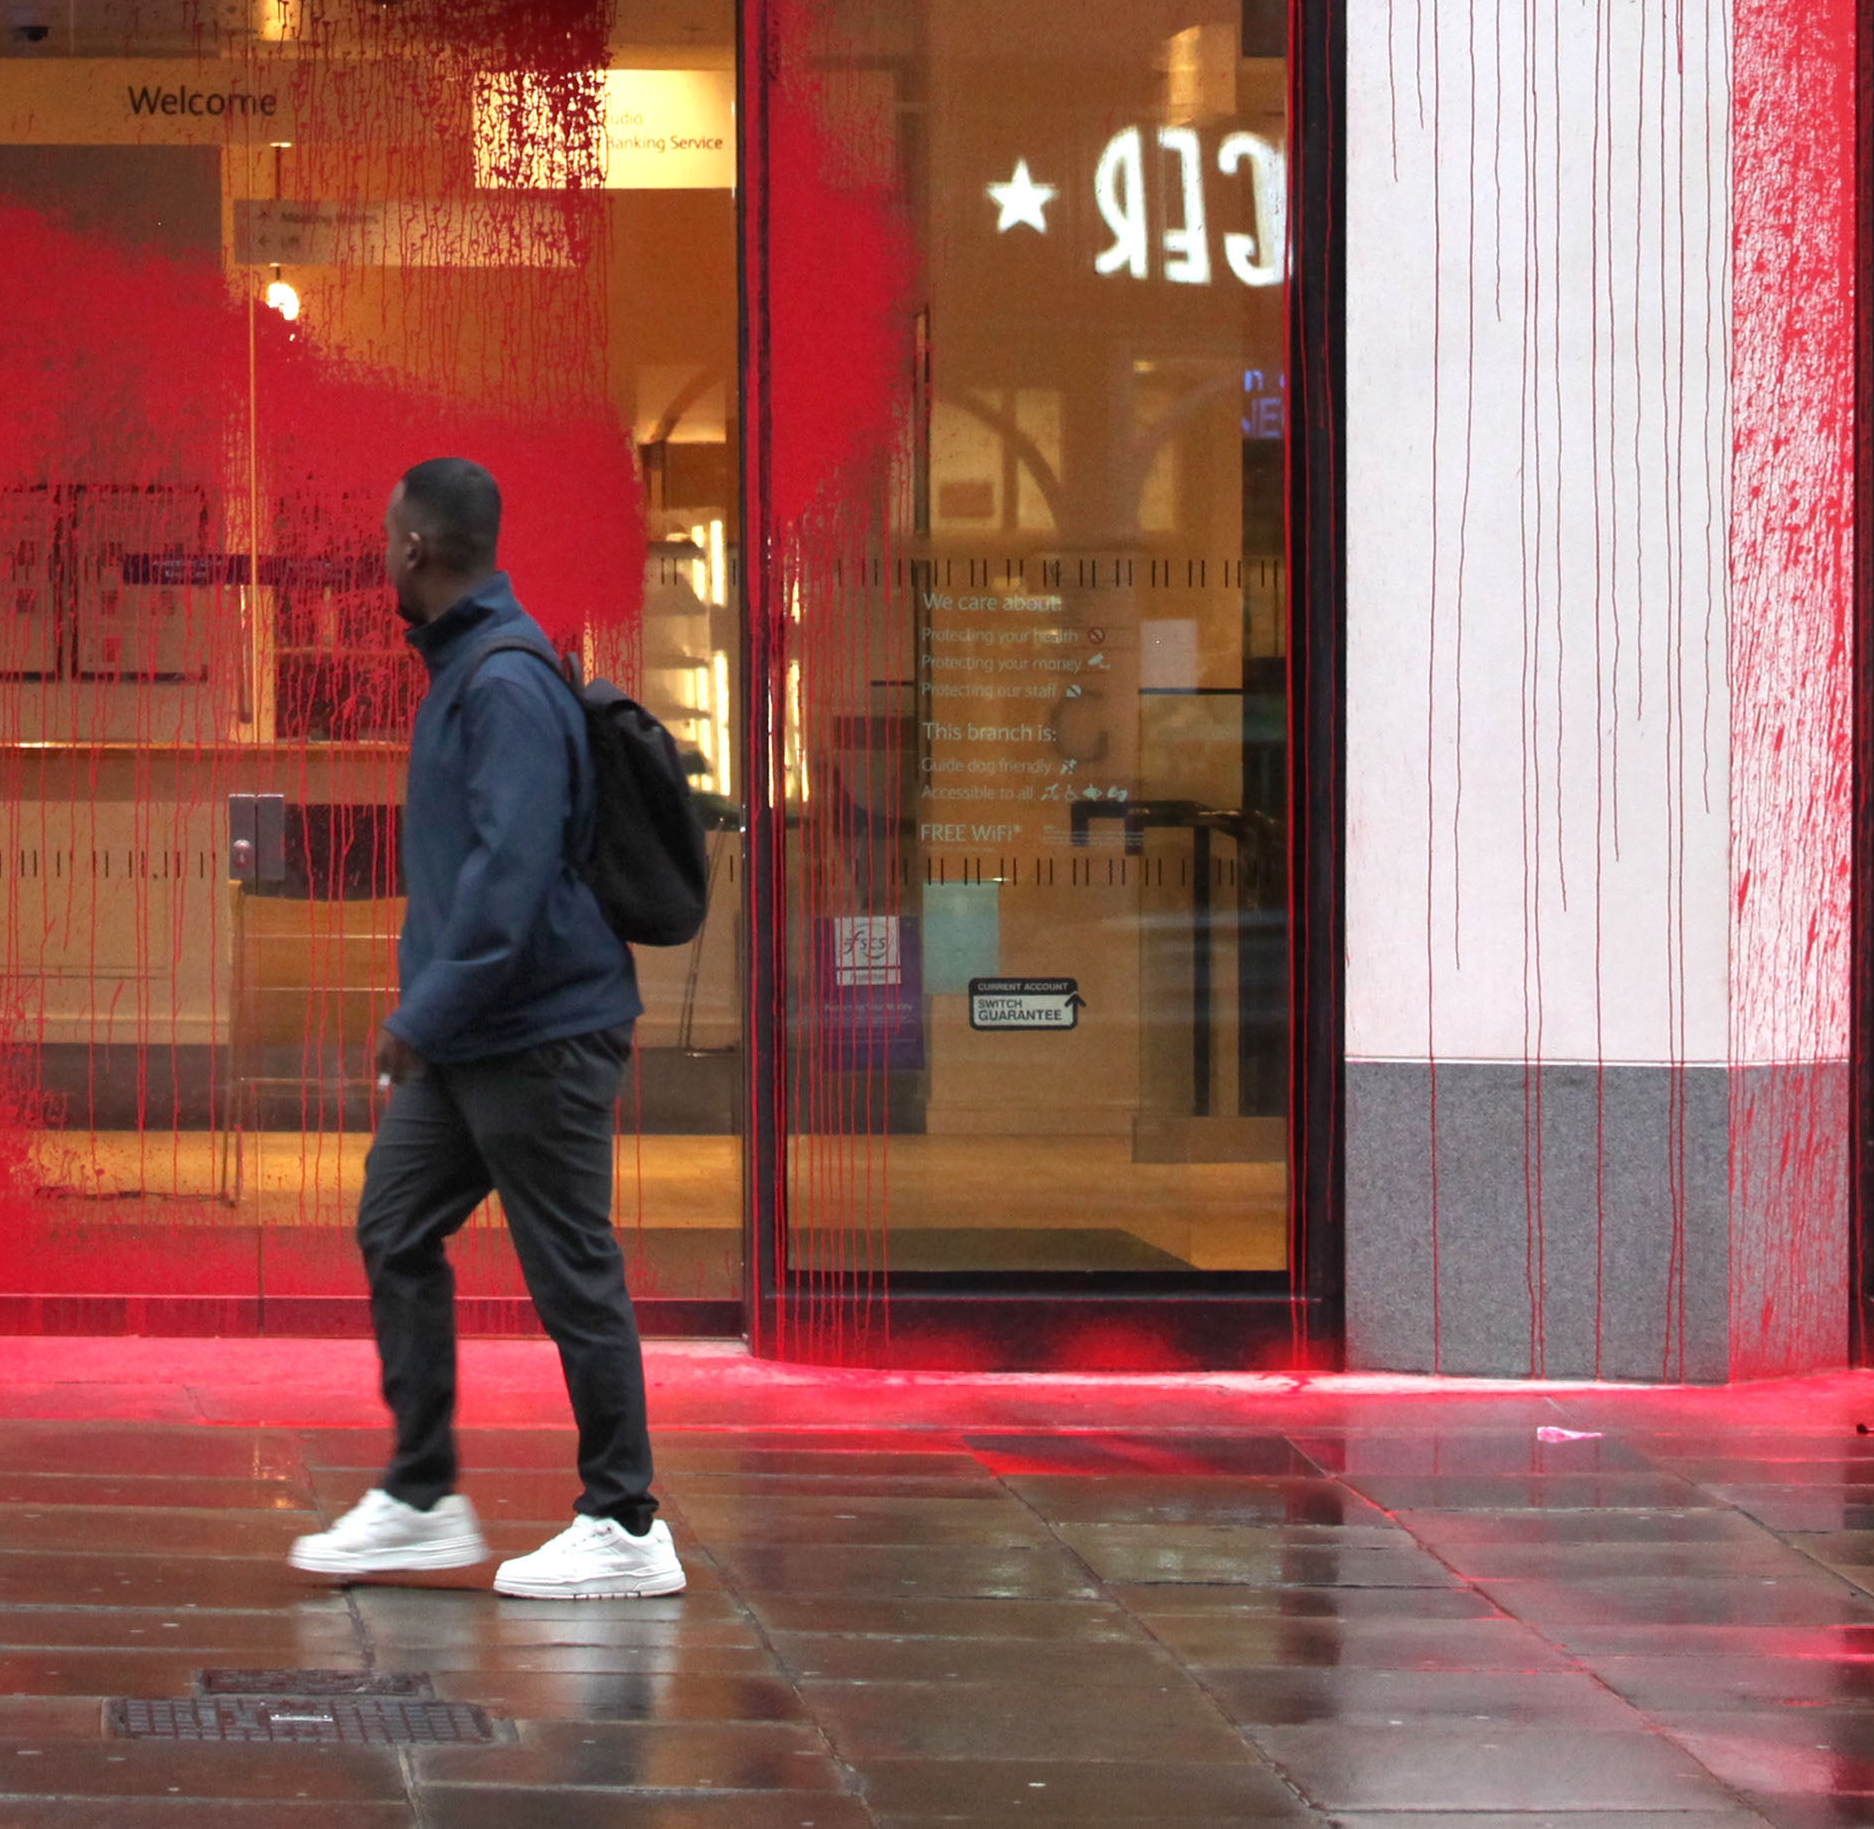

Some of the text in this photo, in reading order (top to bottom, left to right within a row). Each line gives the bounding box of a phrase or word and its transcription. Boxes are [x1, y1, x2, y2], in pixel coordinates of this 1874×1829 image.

[128, 84, 278, 117] Welcome
[606, 113, 644, 125] tudio
[607, 134, 666, 153] Banking
[670, 134, 724, 150] Service
[923, 593, 954, 611] We
[958, 596, 998, 611] care
[922, 626, 1078, 646] Protecting your health
[921, 654, 1082, 674] Protecting your money
[1025, 683, 1058, 698] staff
[923, 722, 1058, 742] This branch is:
[922, 757, 1052, 775] Guide dog friendly
[922, 784, 1034, 800] Accessible to all
[921, 824, 967, 843] FREE
[977, 982, 1069, 992] CURRENT ACCOUNT
[977, 998, 1023, 1009] SWITCH
[977, 1009, 1063, 1022] GUARANTEE
